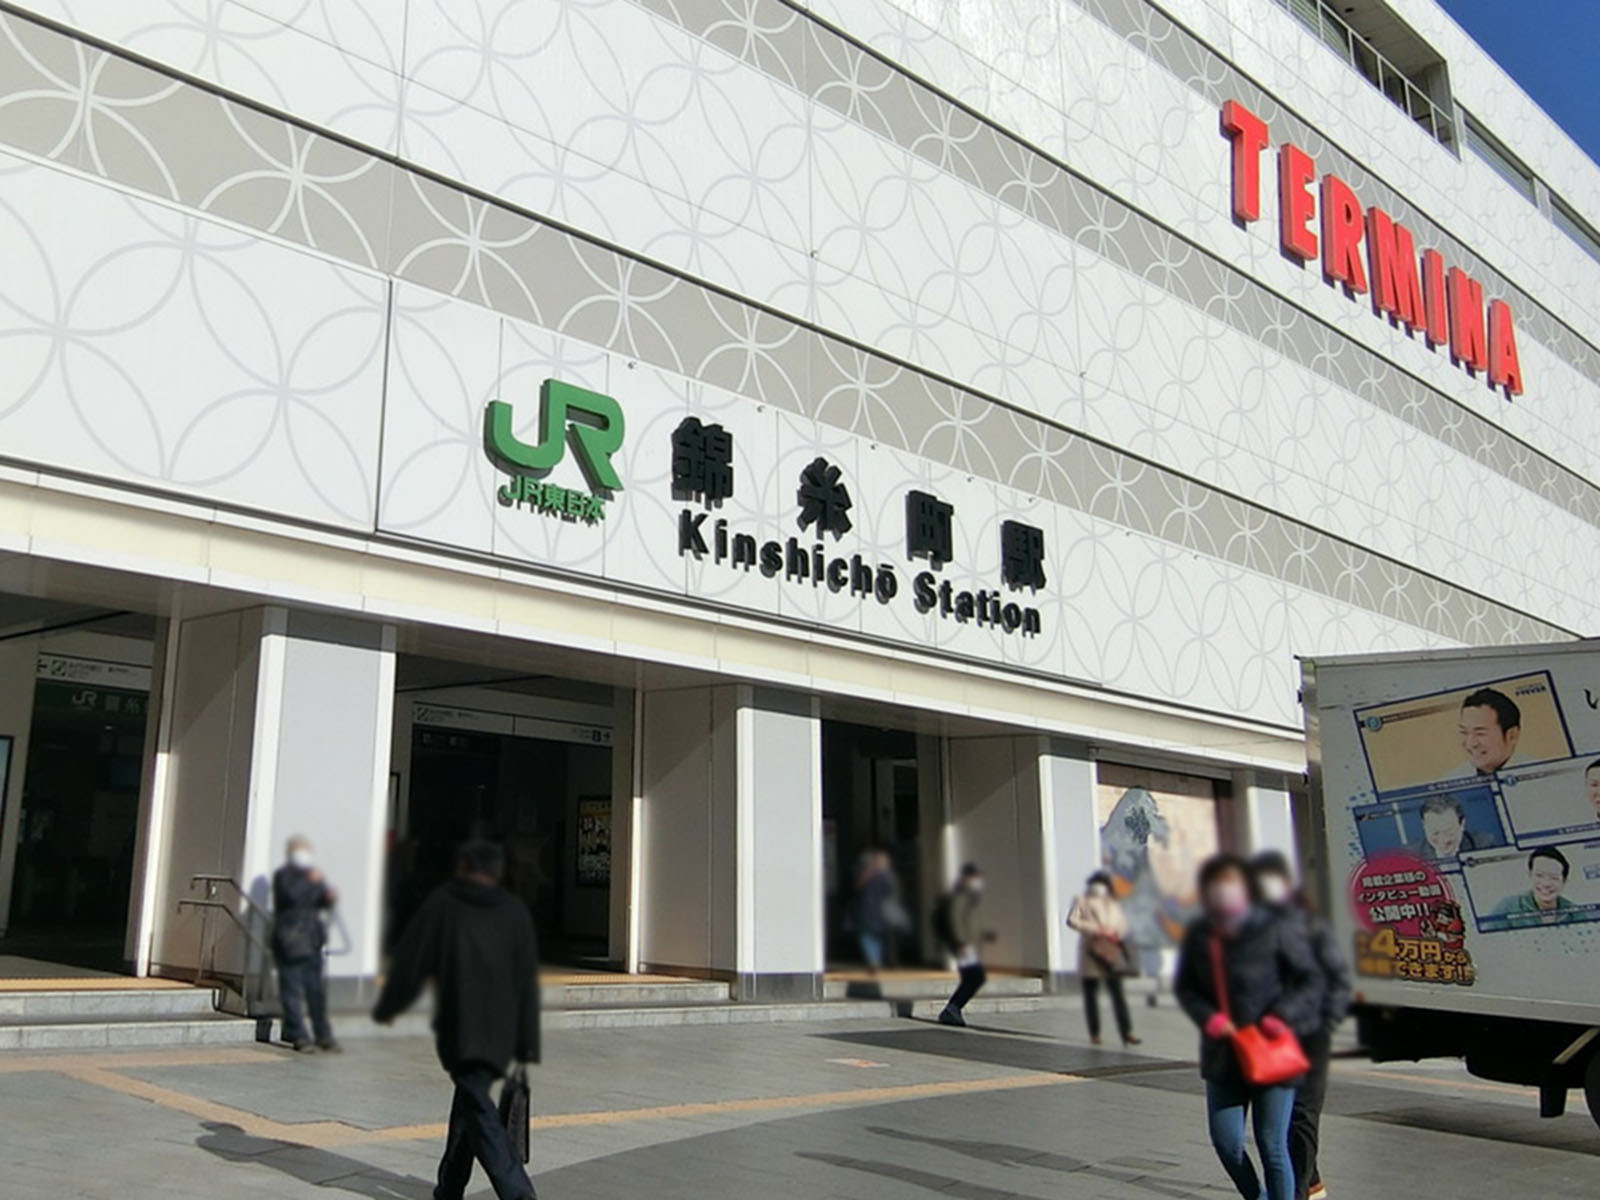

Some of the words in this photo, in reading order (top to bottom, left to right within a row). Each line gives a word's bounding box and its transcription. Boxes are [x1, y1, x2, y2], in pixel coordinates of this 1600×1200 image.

[1220, 100, 1523, 398] TERMINA
[484, 378, 625, 492] JR
[498, 474, 606, 519] JR東日本
[679, 508, 899, 604] Kinshichō
[914, 570, 1042, 638] Station
[1357, 928, 1468, 963] 4万円から
